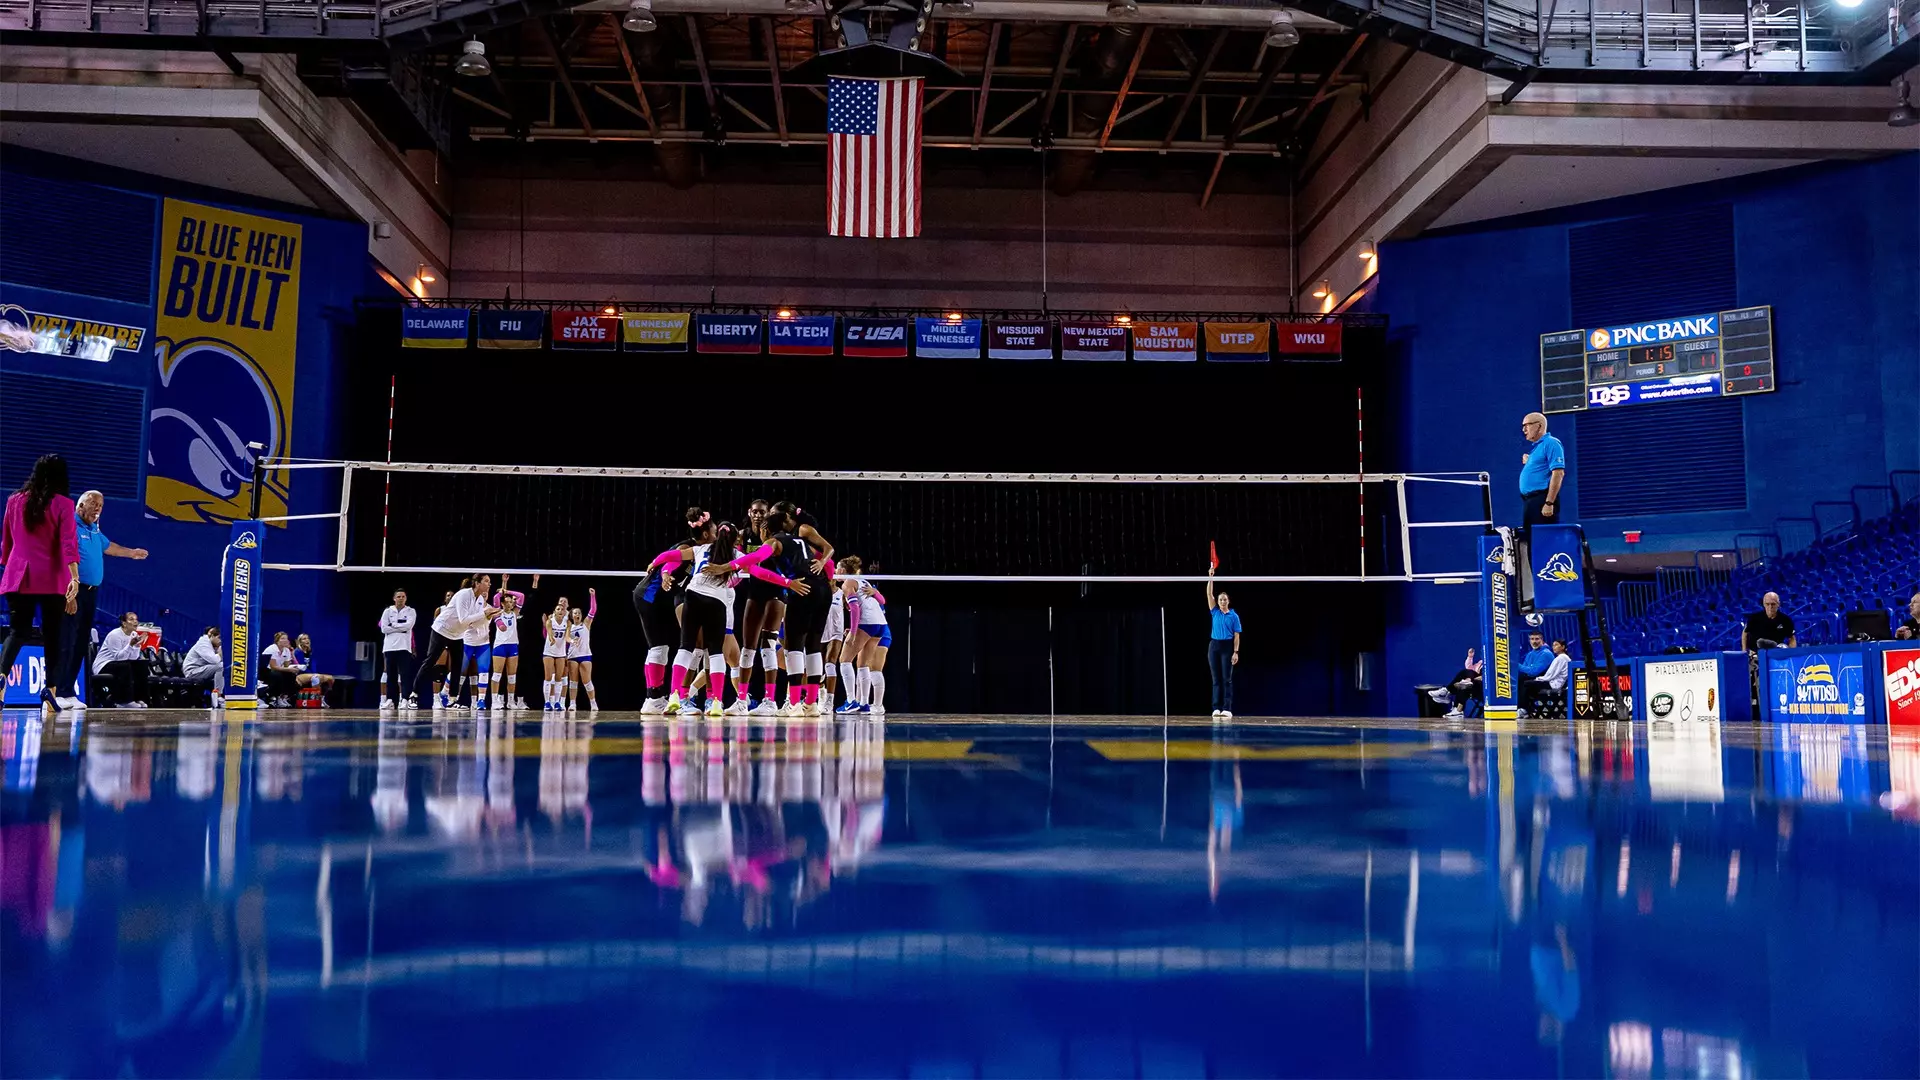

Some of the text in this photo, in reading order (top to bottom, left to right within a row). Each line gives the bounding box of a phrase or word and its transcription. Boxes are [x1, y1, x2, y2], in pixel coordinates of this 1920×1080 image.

[176, 216, 297, 271] BLUE HEN
[163, 254, 290, 331] BUILT
[407, 319, 465, 329] DELAWARE
[500, 320, 522, 331] FIU
[571, 316, 598, 327] JAX
[628, 319, 684, 328] KENNESAW
[31, 315, 142, 349] DELAWARE
[563, 327, 606, 339] STATE
[640, 330, 671, 340] STATE
[702, 324, 757, 336] LIBERTY
[774, 325, 829, 338] LA TECH
[931, 325, 967, 334] MIDDLE
[997, 326, 1044, 335] MISSOURI
[1064, 327, 1124, 336] NEW MEXICO
[1150, 327, 1179, 338] SAM
[921, 334, 975, 344] TENNESSEE
[1006, 336, 1035, 346] STATE
[1078, 337, 1109, 347] STATE
[1136, 337, 1194, 349] HOUSTON
[1220, 332, 1255, 345] UTEP
[1294, 332, 1325, 345] WKU
[1684, 341, 1710, 351] GUEST
[1597, 352, 1619, 362] HOME
[1645, 345, 1672, 360] 1:15
[1657, 363, 1664, 374] 3
[793, 538, 808, 560] 7
[233, 560, 249, 686] DELAWARE BLUE HENS
[1493, 574, 1510, 697] DELAWARE BLUE HENS
[1656, 661, 1714, 675] PIAZZA DELAWARE
